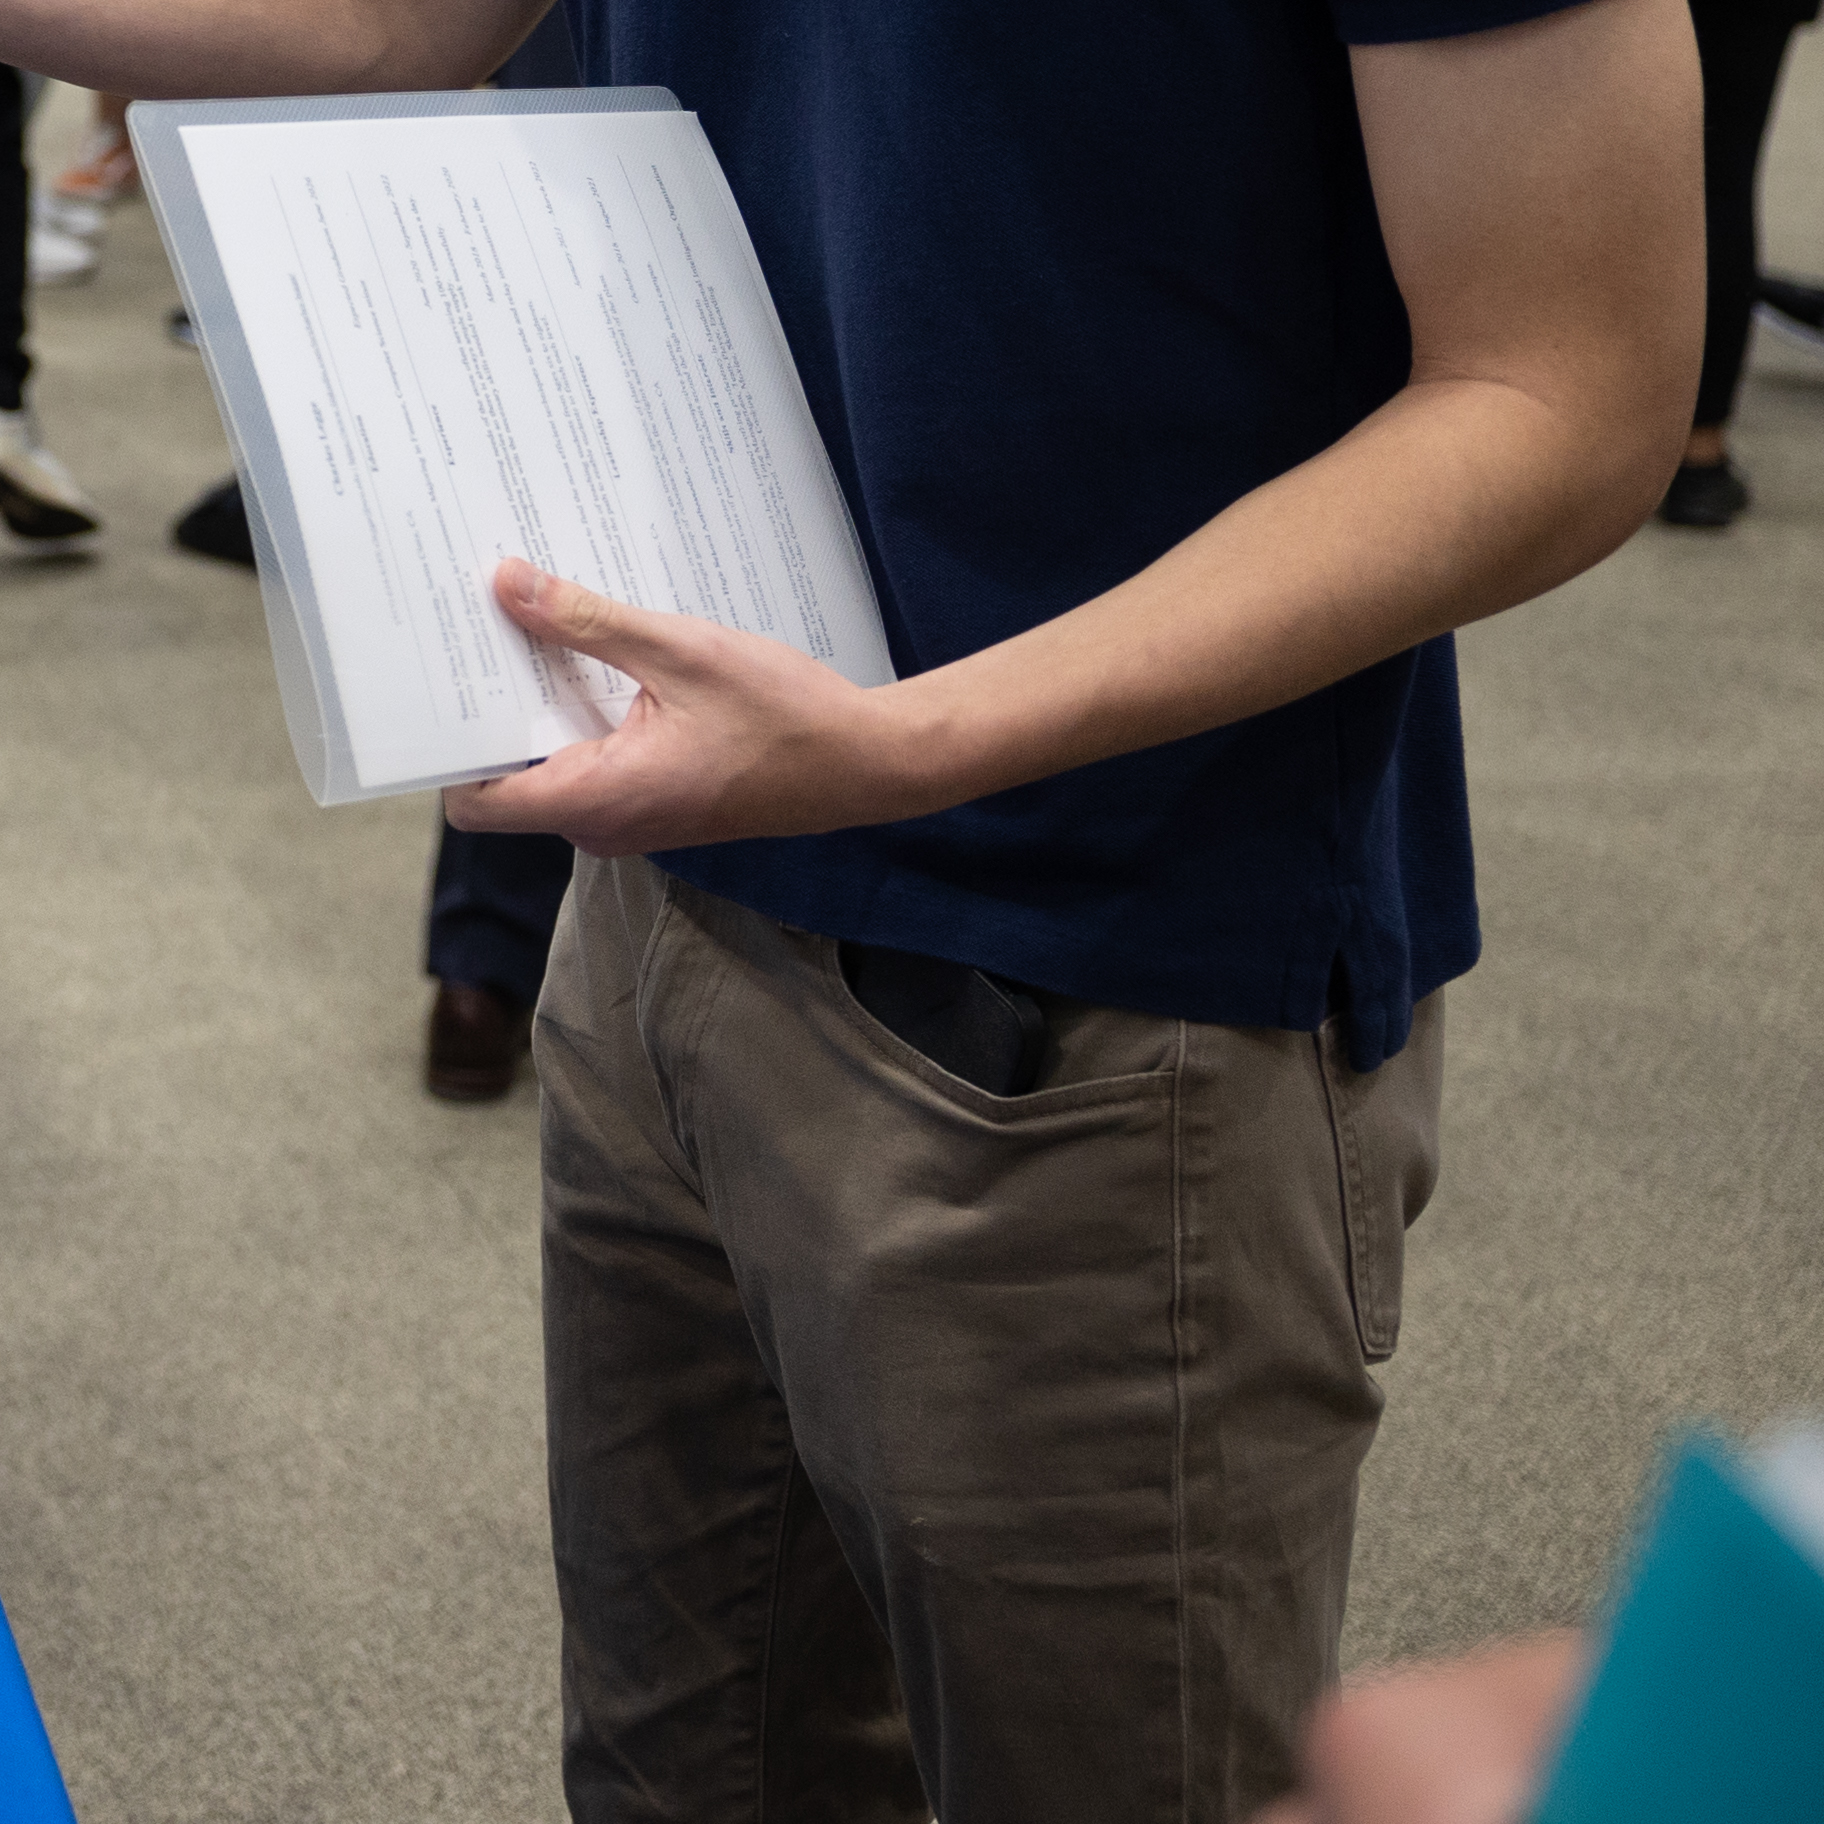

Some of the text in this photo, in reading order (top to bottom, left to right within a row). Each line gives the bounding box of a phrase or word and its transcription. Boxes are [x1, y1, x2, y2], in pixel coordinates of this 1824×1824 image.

[648, 163, 678, 222] Organization
[477, 270, 495, 303] March
[694, 353, 716, 399] Interests
[474, 398, 486, 415] the
[572, 354, 621, 479] Leadership Experience
[711, 401, 724, 422] and
[353, 414, 378, 473] Education
[428, 403, 456, 466] Experience
[484, 428, 500, 458] needs
[508, 503, 521, 523] and
[529, 537, 542, 557] and
